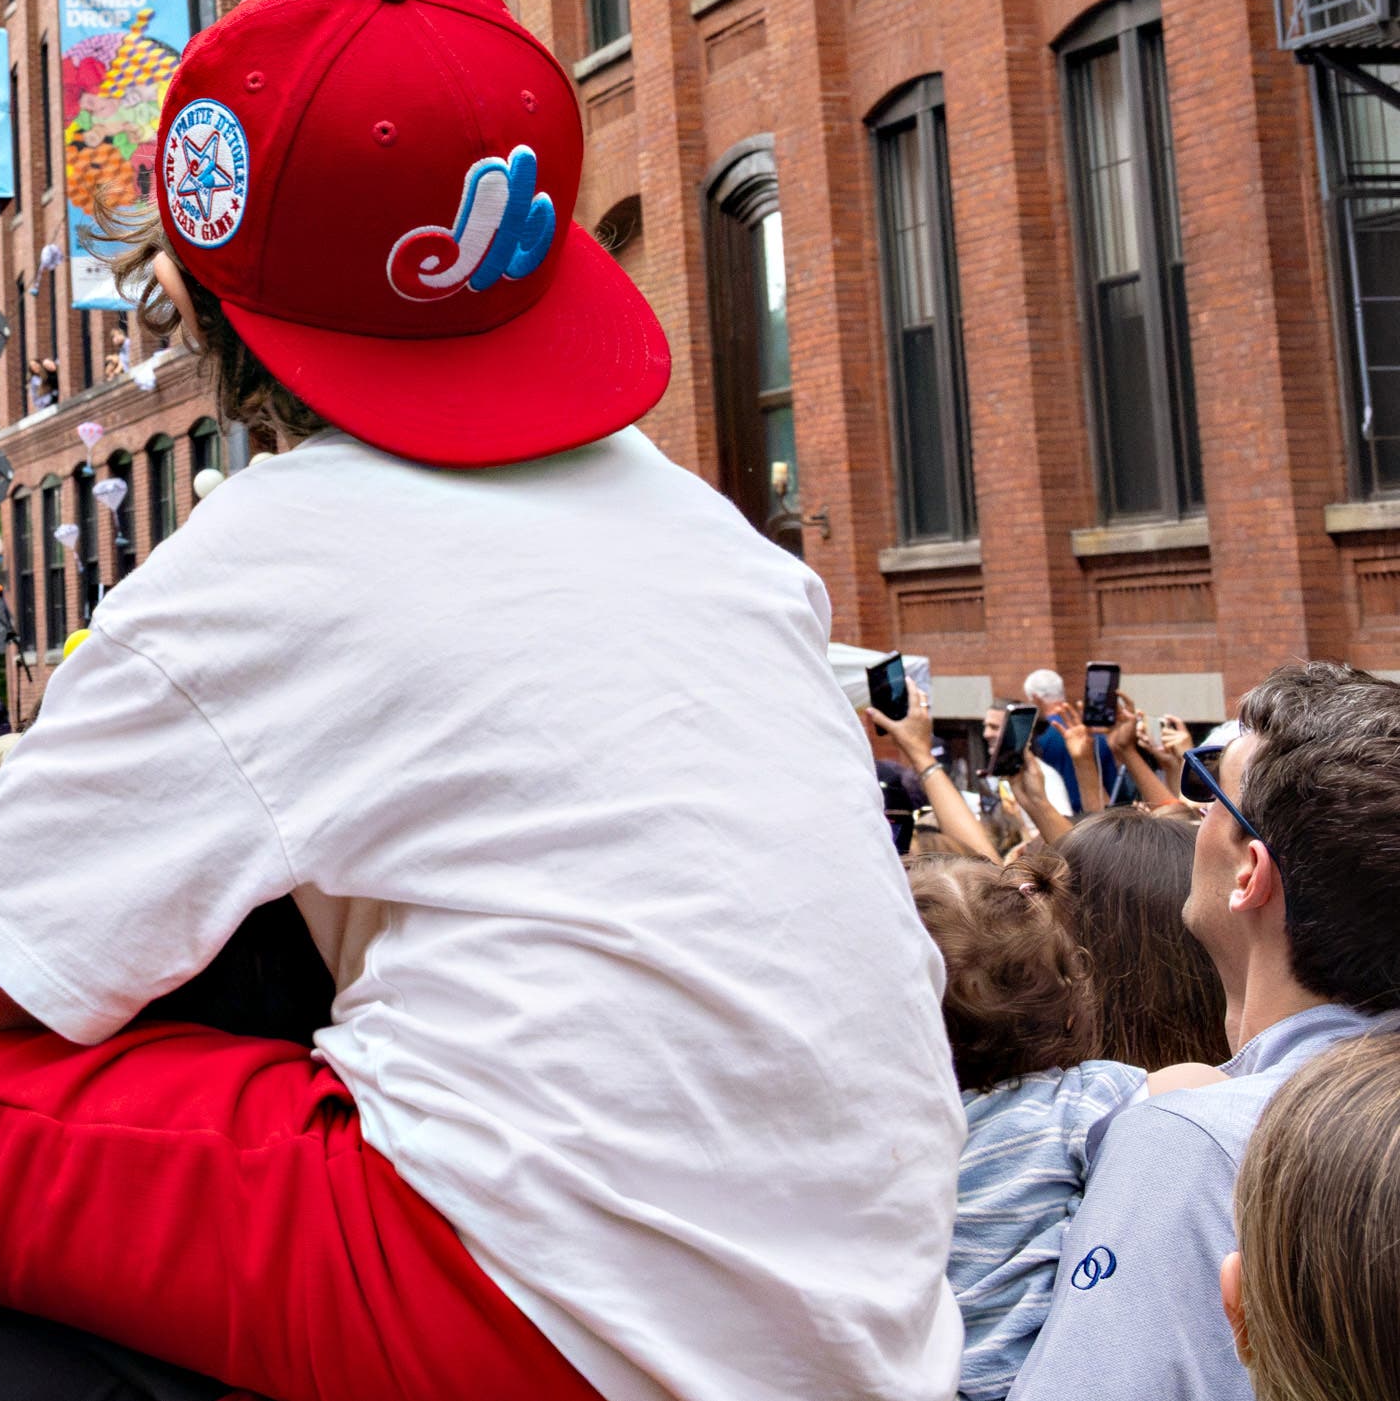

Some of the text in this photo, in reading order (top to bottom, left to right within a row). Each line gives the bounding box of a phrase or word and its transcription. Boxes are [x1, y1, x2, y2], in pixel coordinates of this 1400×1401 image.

[66, 8, 131, 28] DROP
[172, 198, 197, 238] STAR
[201, 211, 235, 242] GAME
